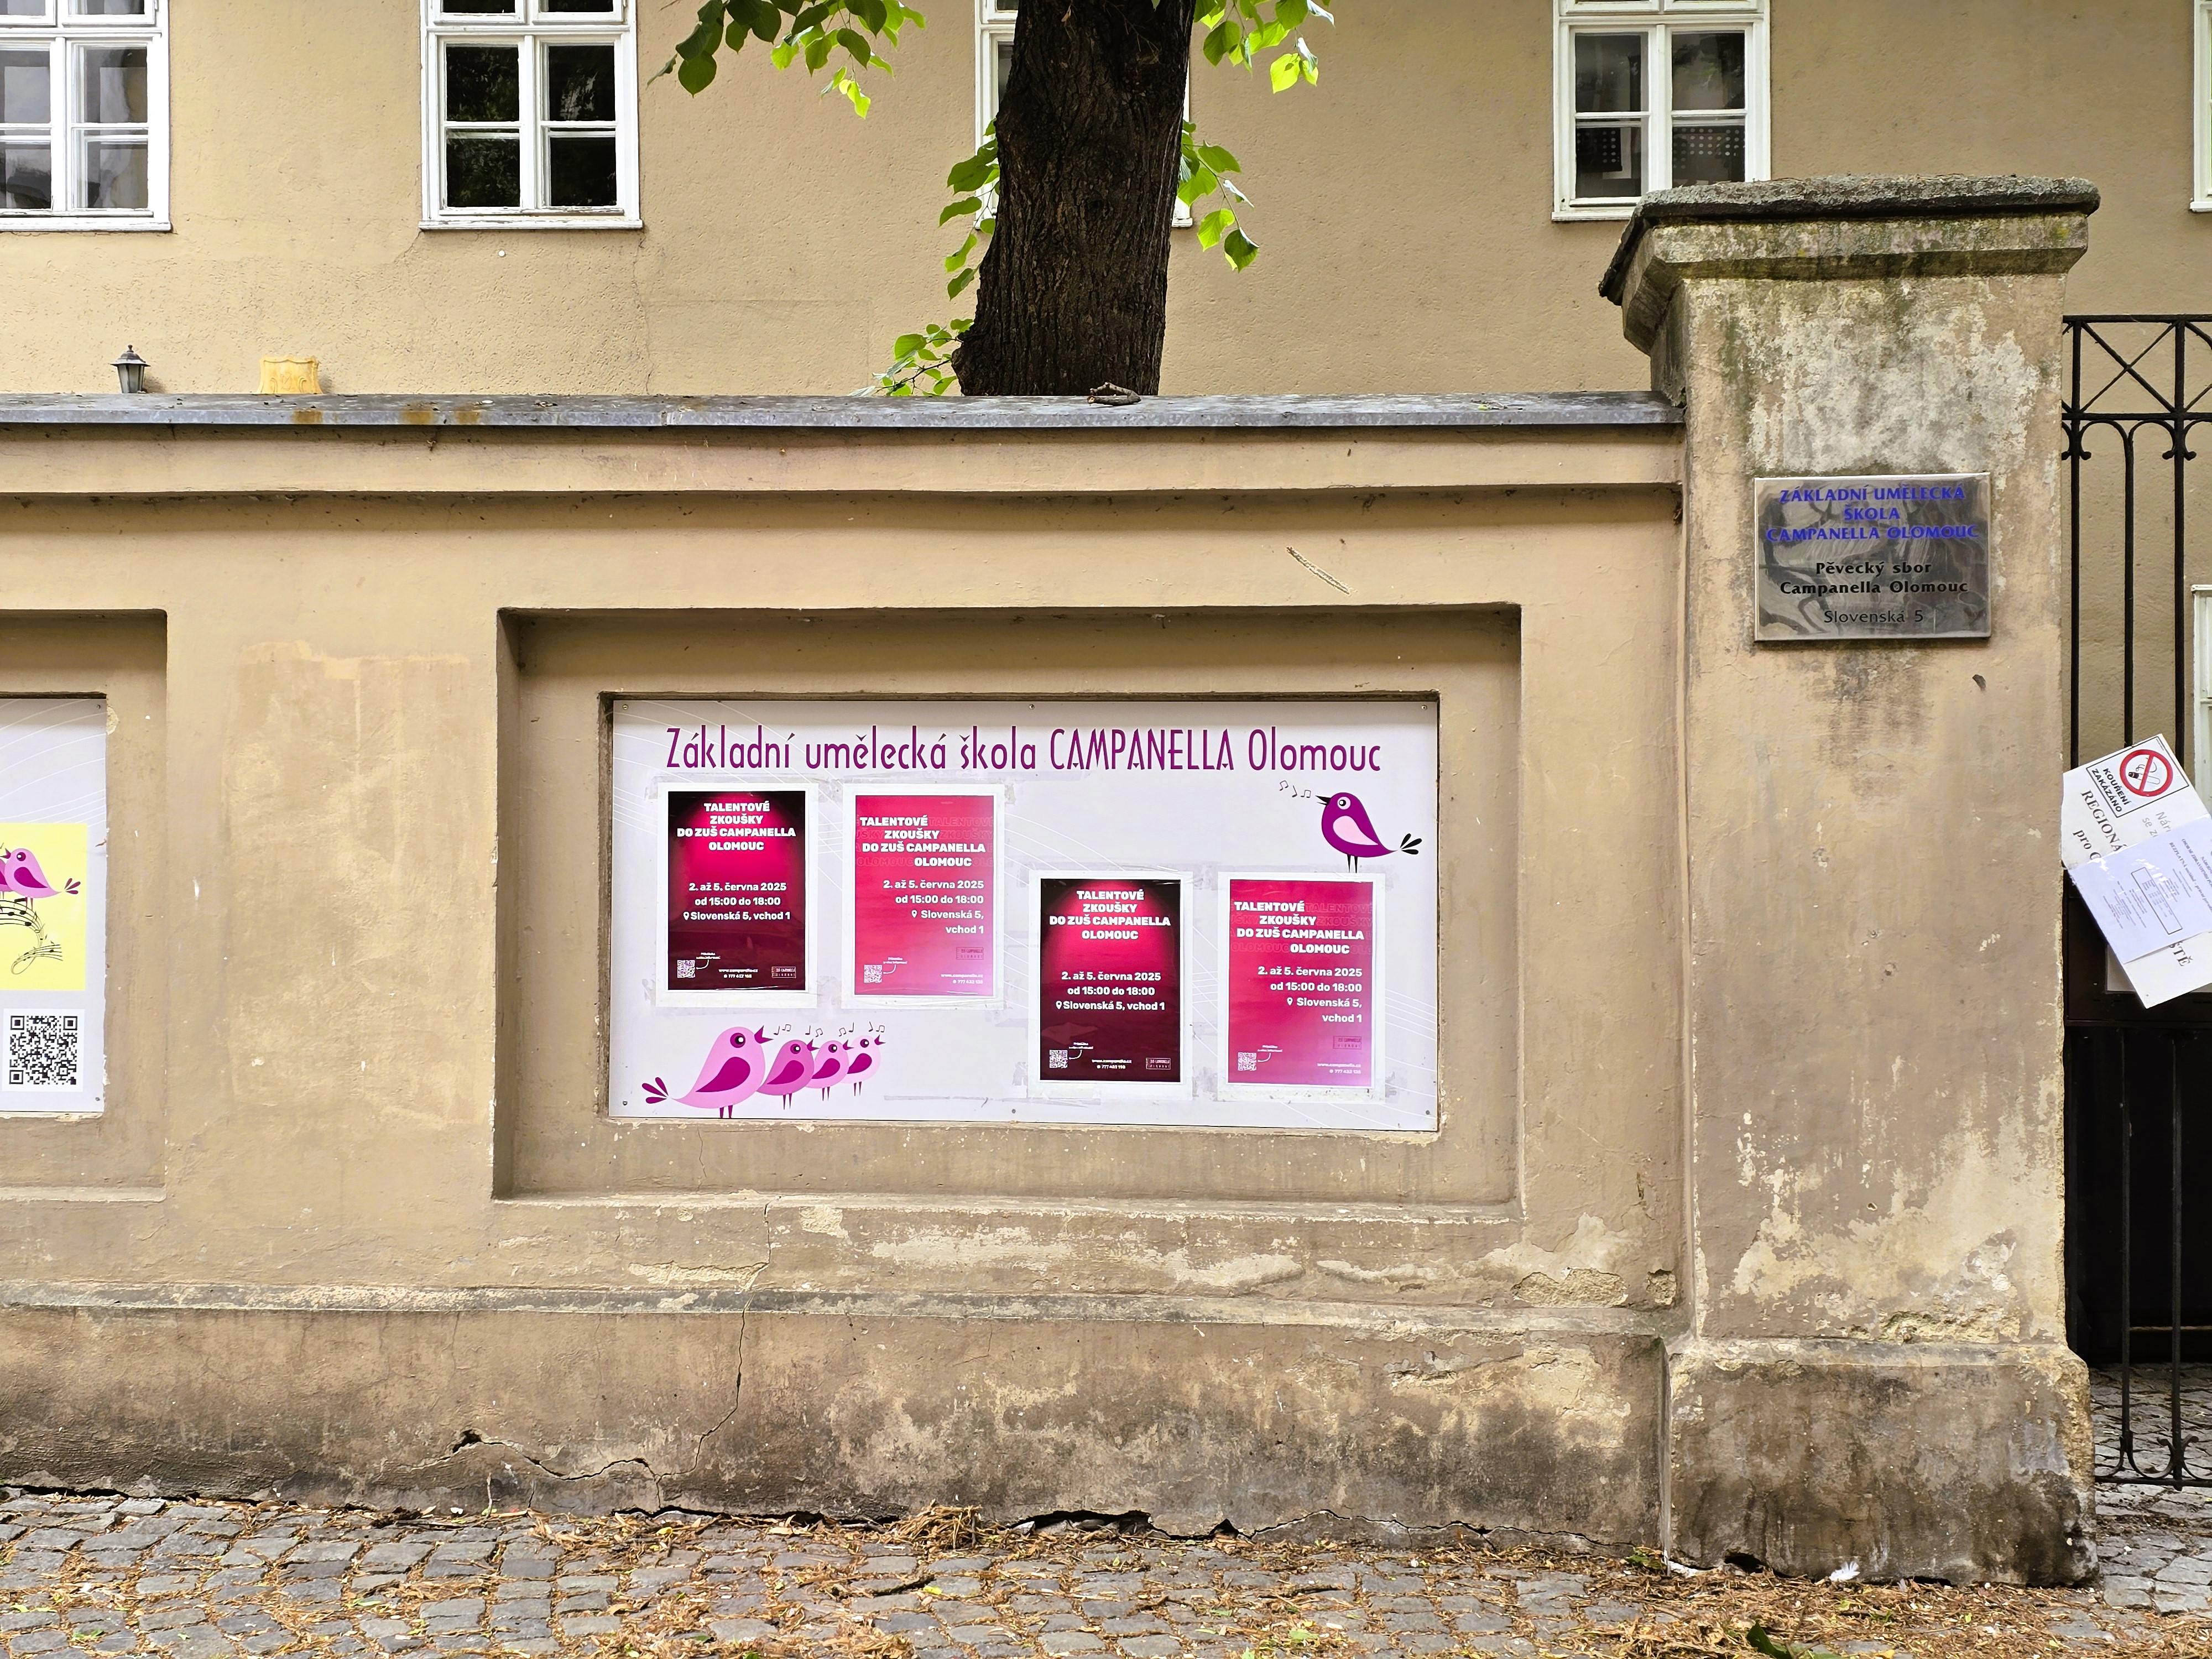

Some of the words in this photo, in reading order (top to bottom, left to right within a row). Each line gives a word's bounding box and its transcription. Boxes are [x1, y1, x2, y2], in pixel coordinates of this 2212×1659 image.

[1779, 484, 1868, 504] ZÁKLADNÍ
[1874, 484, 1965, 500] UMĚLECKÁ
[1844, 505, 1901, 521] ŠKOLA
[1766, 528, 1880, 542] CAMPANELLA
[1887, 525, 1980, 540] OLOMOUC
[1816, 561, 1885, 577] Pěvecký
[1893, 562, 1932, 573] sbor
[1780, 581, 1881, 596] Campanella
[1890, 582, 1968, 593] Olomouc
[1824, 610, 1906, 623] Slovenská
[1914, 610, 1923, 622] 5
[666, 724, 795, 768] Základní
[806, 725, 946, 769] umělecká
[959, 726, 1036, 769] škola
[1050, 728, 1234, 770] CAMPANELLA
[1248, 726, 1381, 771] Olomouc
[2091, 769, 2122, 812] ZAKÁZÁNO
[2103, 768, 2132, 805] KOUŘENÍ
[703, 801, 770, 812] TALENTOVÉ
[709, 813, 764, 825] ZKOUŠKY
[859, 815, 928, 826] TALENTOVÉ
[2142, 817, 2153, 827] se
[677, 828, 693, 837] DO
[695, 826, 718, 837] ZUŠ
[719, 828, 796, 837] CAMPANELLA
[884, 827, 940, 839] ZKOUŠKY
[2073, 830, 2092, 849] pro
[708, 842, 764, 851] OLOMOUC
[862, 843, 879, 852] DO
[880, 841, 905, 852] ZUŠ
[906, 843, 986, 852] CAMPANELLA
[914, 858, 972, 867] OLOMOUC
[700, 883, 712, 891] až
[724, 882, 759, 891] června
[760, 883, 787, 891] 2025
[883, 880, 893, 889] 2.
[894, 880, 907, 889] až
[909, 880, 918, 889] 5.
[920, 879, 955, 889] června
[957, 880, 984, 889] 2025
[895, 895, 908, 904] od
[910, 895, 938, 904] 15:00
[940, 895, 953, 904] do
[955, 895, 984, 904] 18:00
[1076, 889, 1144, 900] TALENTOVÉ
[695, 897, 707, 905] od
[709, 897, 737, 905] 15:00
[738, 897, 751, 905] do
[753, 897, 780, 905] 18:00
[1083, 901, 1138, 912] ZKOUŠKY
[1234, 900, 1305, 912] TALENTOVÉ
[690, 911, 740, 920] Slovenská
[753, 912, 784, 920] vchod
[785, 912, 790, 920] 1
[921, 910, 973, 919] Slovenská
[974, 911, 984, 920] 5,
[1050, 916, 1066, 925] DO
[1067, 914, 1091, 925] ZUŠ
[1092, 916, 1171, 926] CAMPANELLA
[1259, 914, 1317, 926] ZKOUŠKY
[946, 925, 977, 933] vchod
[978, 925, 984, 933] 1
[1237, 928, 1254, 937] DO
[1255, 926, 1280, 938] ZUŠ
[1282, 928, 1365, 940] CAMPANELLA
[1082, 930, 1139, 940] OLOMOUC
[1290, 944, 1350, 954] OLOMOUC
[1061, 972, 1071, 980] 2.
[1073, 971, 1084, 980] až
[1086, 972, 1095, 980] 5.
[1098, 971, 1133, 980] června
[1134, 972, 1161, 981] 2025
[1258, 966, 1268, 975] 2.
[1270, 966, 1282, 975] až
[1284, 967, 1294, 975] 5.
[1296, 966, 1332, 976] června
[1334, 968, 1363, 977] 2025
[1067, 987, 1080, 995] od
[1082, 987, 1110, 995] 15:00
[1112, 987, 1125, 995] do
[1126, 987, 1155, 995] 18:00
[1270, 982, 1284, 990] od
[1285, 982, 1315, 990] 15:00
[1317, 983, 1331, 991] do
[1332, 983, 1362, 992] 18:00
[1063, 1000, 1114, 1010] Slovenská
[1115, 1001, 1125, 1010] 5,
[1127, 1001, 1157, 1010] vchod
[1159, 1002, 1165, 1010] 1
[1297, 998, 1350, 1007] Slovenská
[1352, 999, 1362, 1008] 5,
[1322, 1014, 1354, 1022] vchod
[1356, 1014, 1362, 1022] 1
